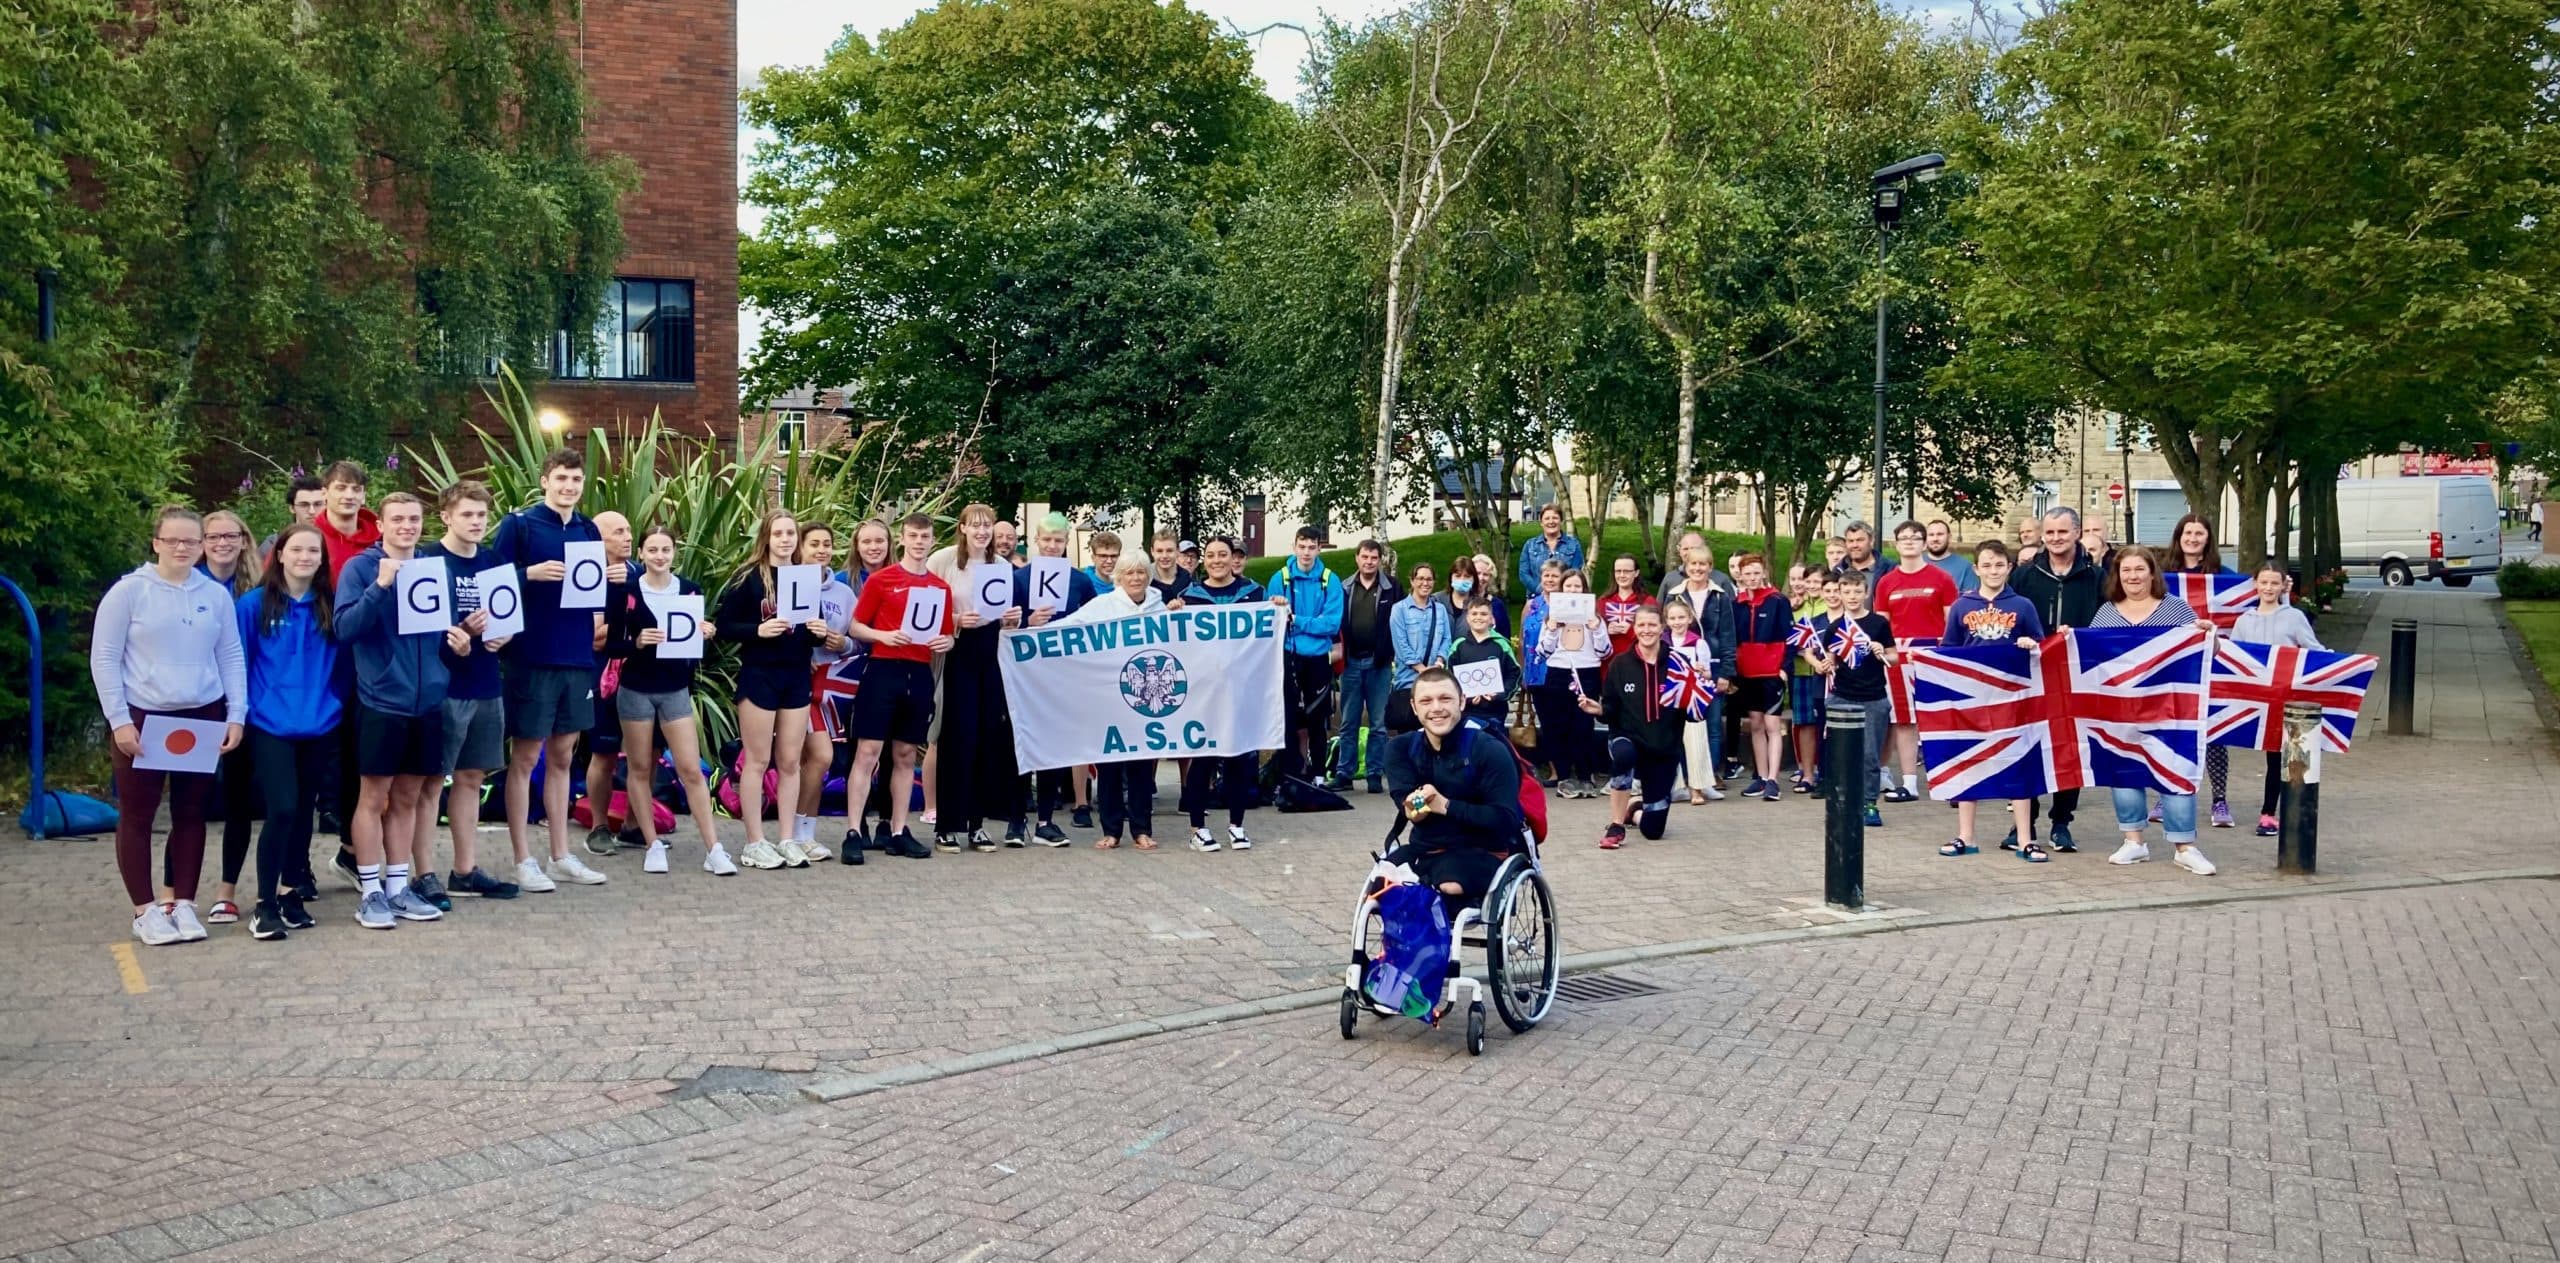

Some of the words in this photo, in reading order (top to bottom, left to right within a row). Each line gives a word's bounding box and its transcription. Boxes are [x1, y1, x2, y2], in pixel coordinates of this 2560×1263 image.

[572, 560, 602, 591] O
[1038, 570, 1060, 598] K
[408, 578, 440, 613] G
[488, 585, 517, 620] O
[792, 581, 810, 611] L
[982, 579, 1006, 607] C
[666, 611, 696, 643] D
[911, 603, 938, 631] U
[1012, 608, 1276, 662] DERWENTSIDE
